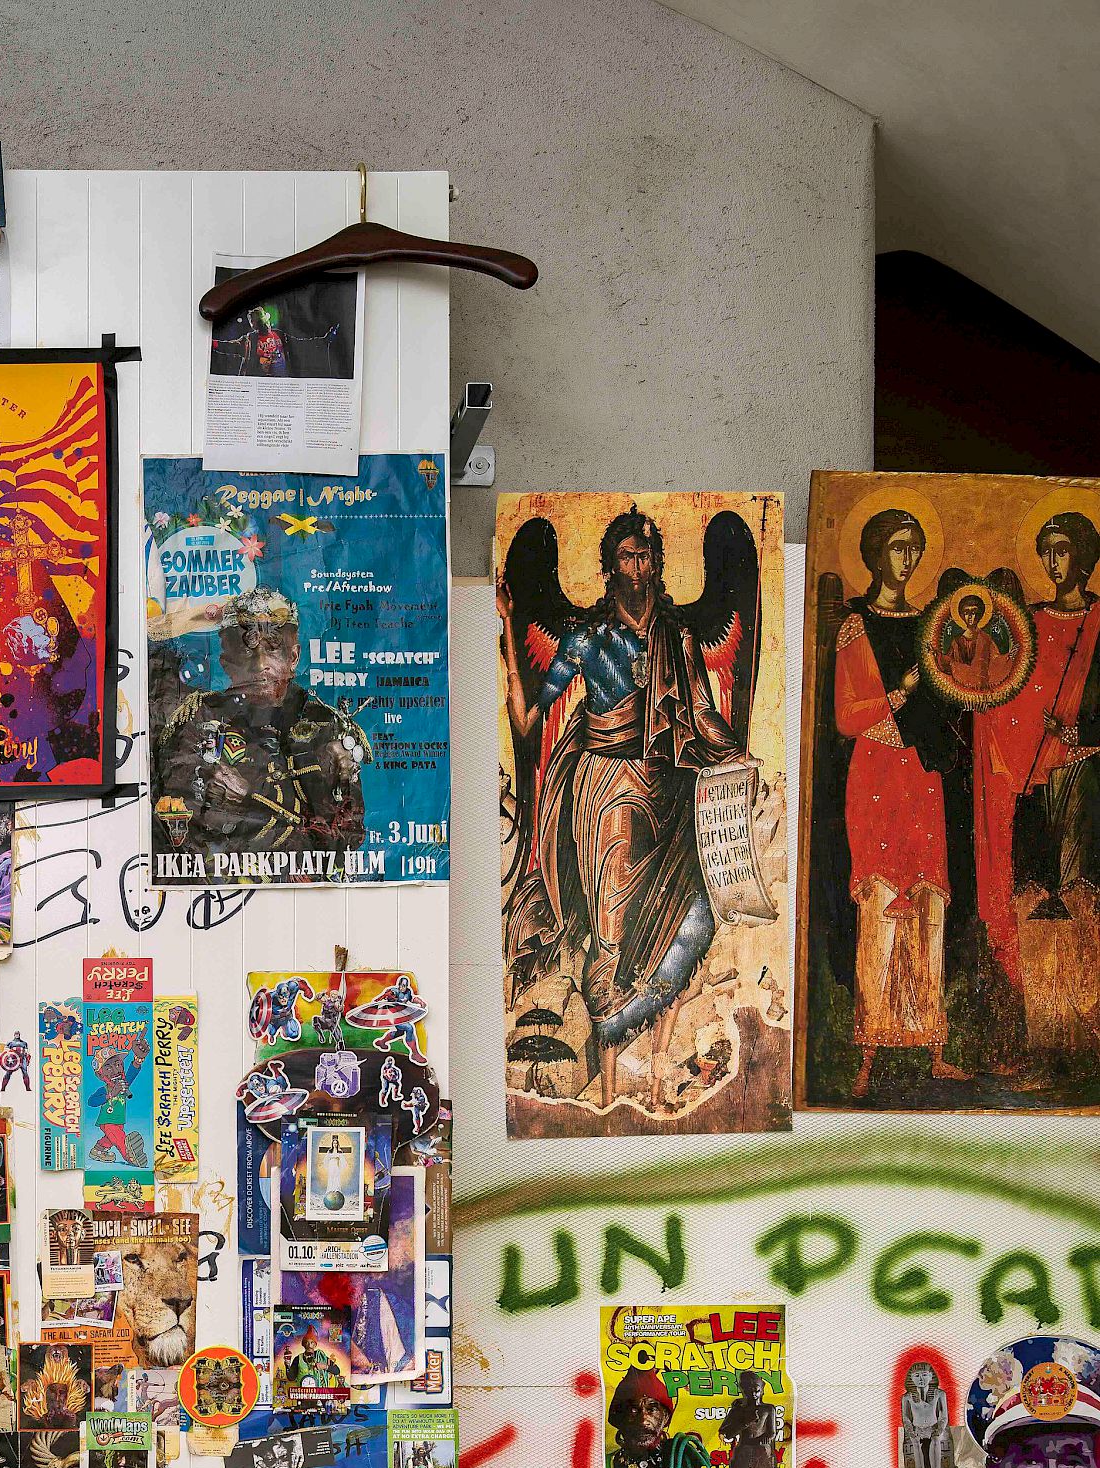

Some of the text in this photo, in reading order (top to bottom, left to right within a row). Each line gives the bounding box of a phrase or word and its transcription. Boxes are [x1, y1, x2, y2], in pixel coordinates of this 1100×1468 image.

[215, 485, 296, 510] Reggae
[160, 549, 246, 573] SOMMER
[310, 569, 374, 578] Soundsystem
[165, 573, 242, 598] ZAUBER
[303, 581, 392, 593] Pre/Aftershow
[309, 638, 440, 665] LEE "SCRATCH"
[310, 669, 368, 687] PERRY
[399, 696, 446, 709] upsetter
[384, 712, 403, 724] live
[383, 761, 408, 770] KING
[411, 761, 437, 769] PATA
[155, 852, 207, 879] IKEA
[214, 850, 336, 877] PARKPLATZ
[44, 1127, 52, 1167] FIGURINE
[130, 1219, 191, 1237] SMELL SEE
[496, 1211, 689, 1314] UN
[624, 1314, 676, 1323] SUPER APE
[709, 1312, 780, 1342] LEE
[43, 1328, 130, 1340] THE ALL SAFARI ZOO
[606, 1341, 782, 1372] SCRATCH
